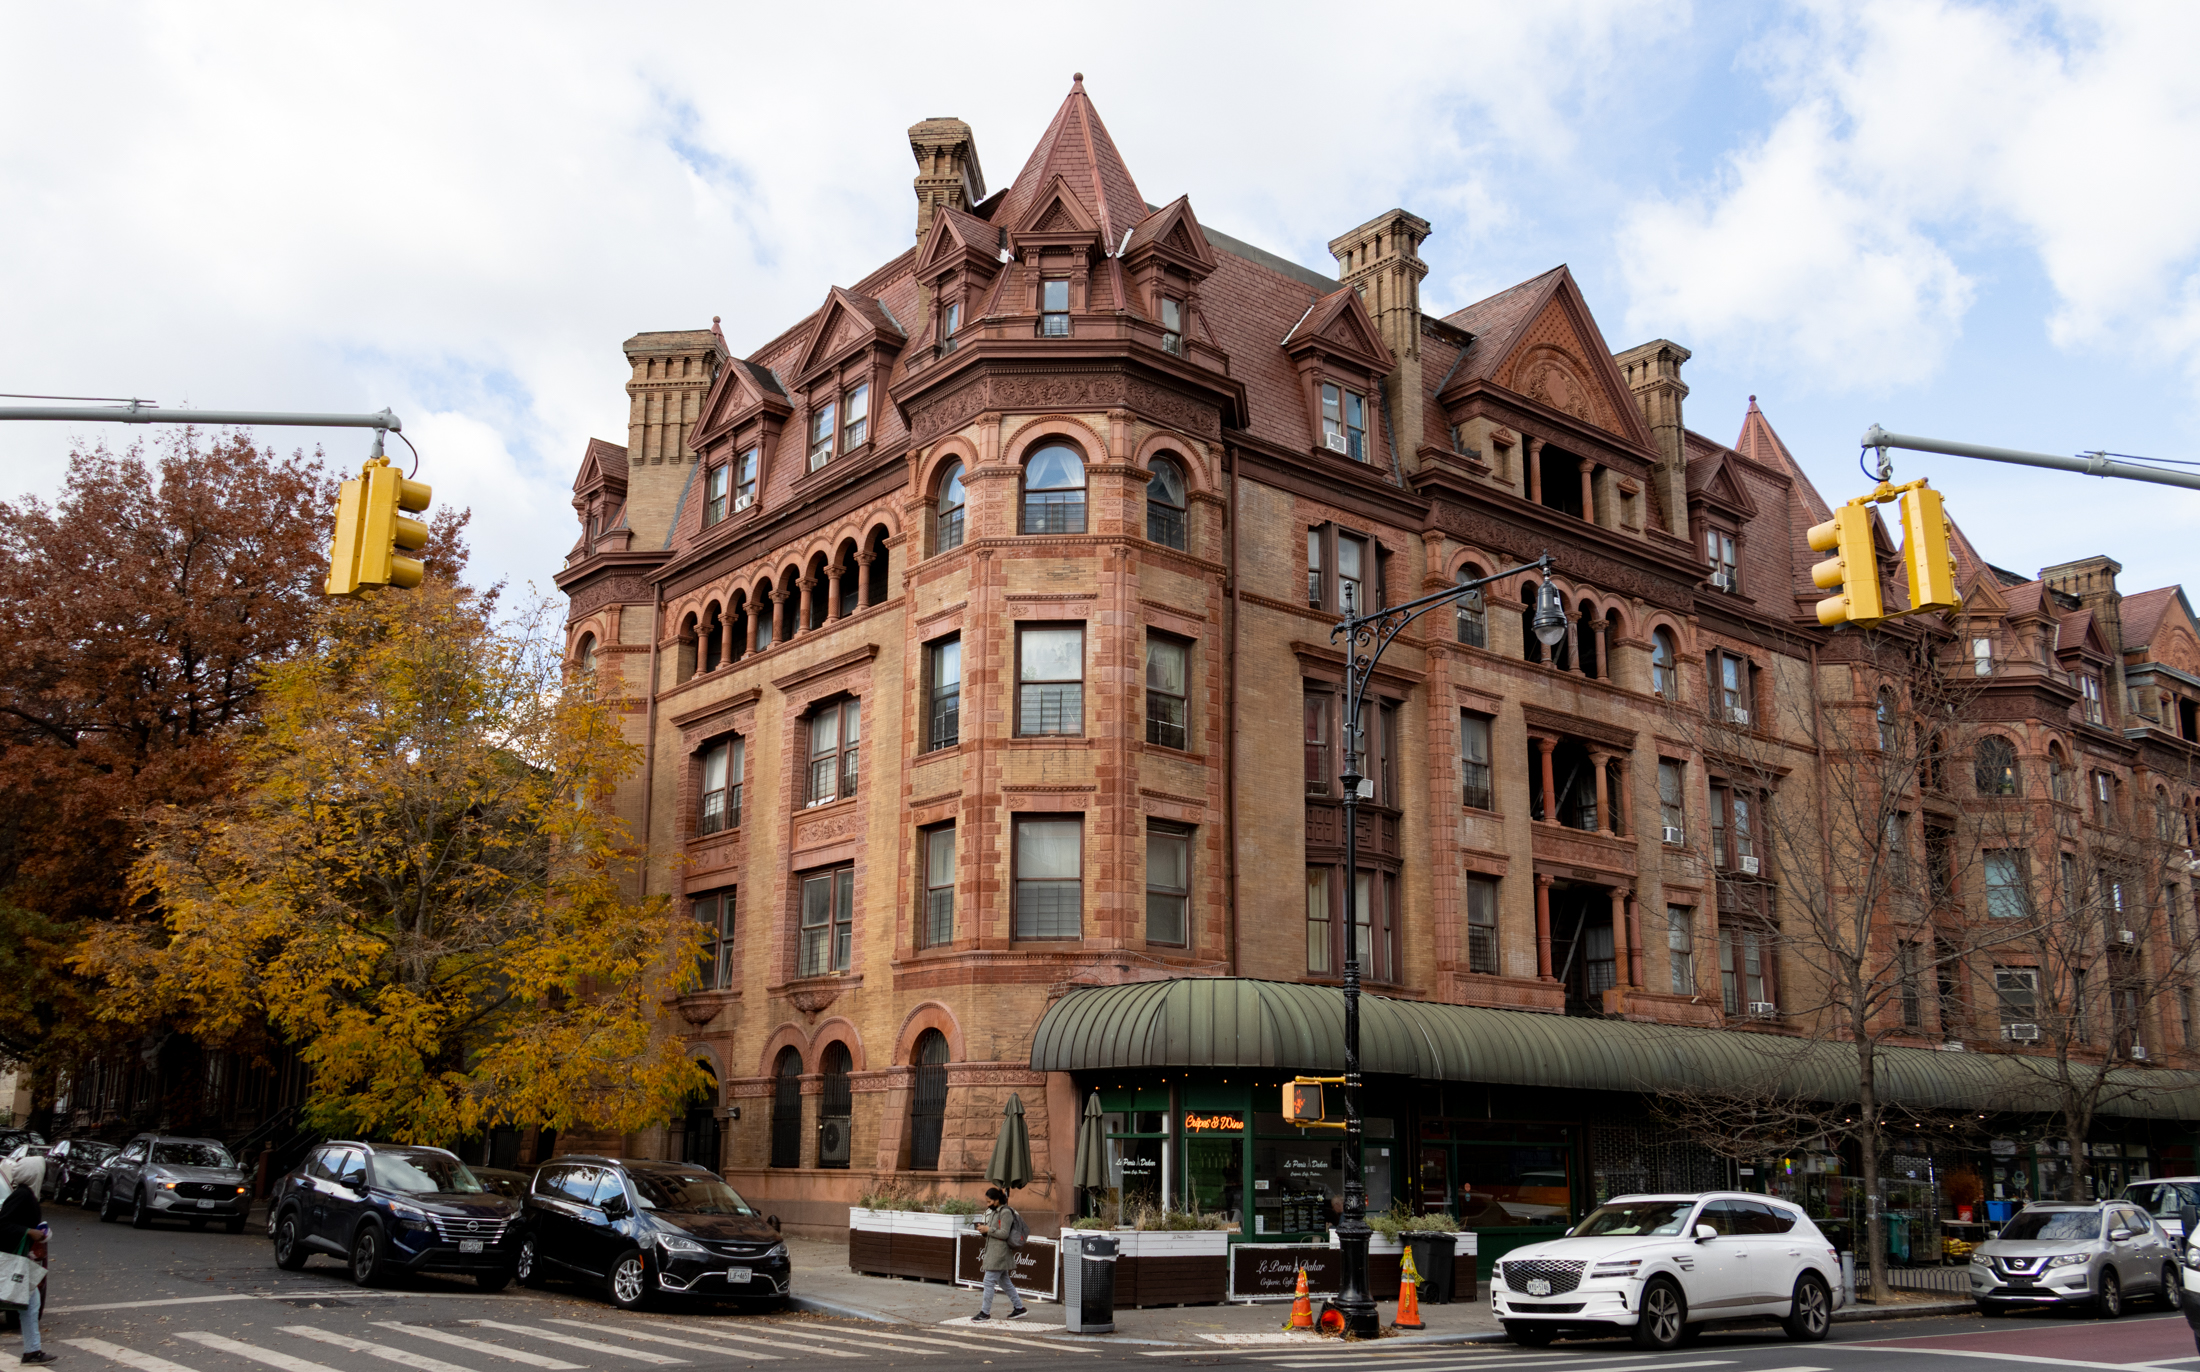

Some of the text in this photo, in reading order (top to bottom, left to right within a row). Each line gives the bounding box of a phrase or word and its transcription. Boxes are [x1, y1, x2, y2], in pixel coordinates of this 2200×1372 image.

[1211, 1116, 1219, 1128] &
[1220, 1116, 1244, 1129] Wine
[1115, 1158, 1156, 1166] Le Paris Dakar
[1293, 1160, 1306, 1168] Paris
[1312, 1160, 1328, 1168] Dakar
[1014, 1252, 1036, 1266] Dakar
[1256, 1259, 1325, 1274] Le Paris Dakar
